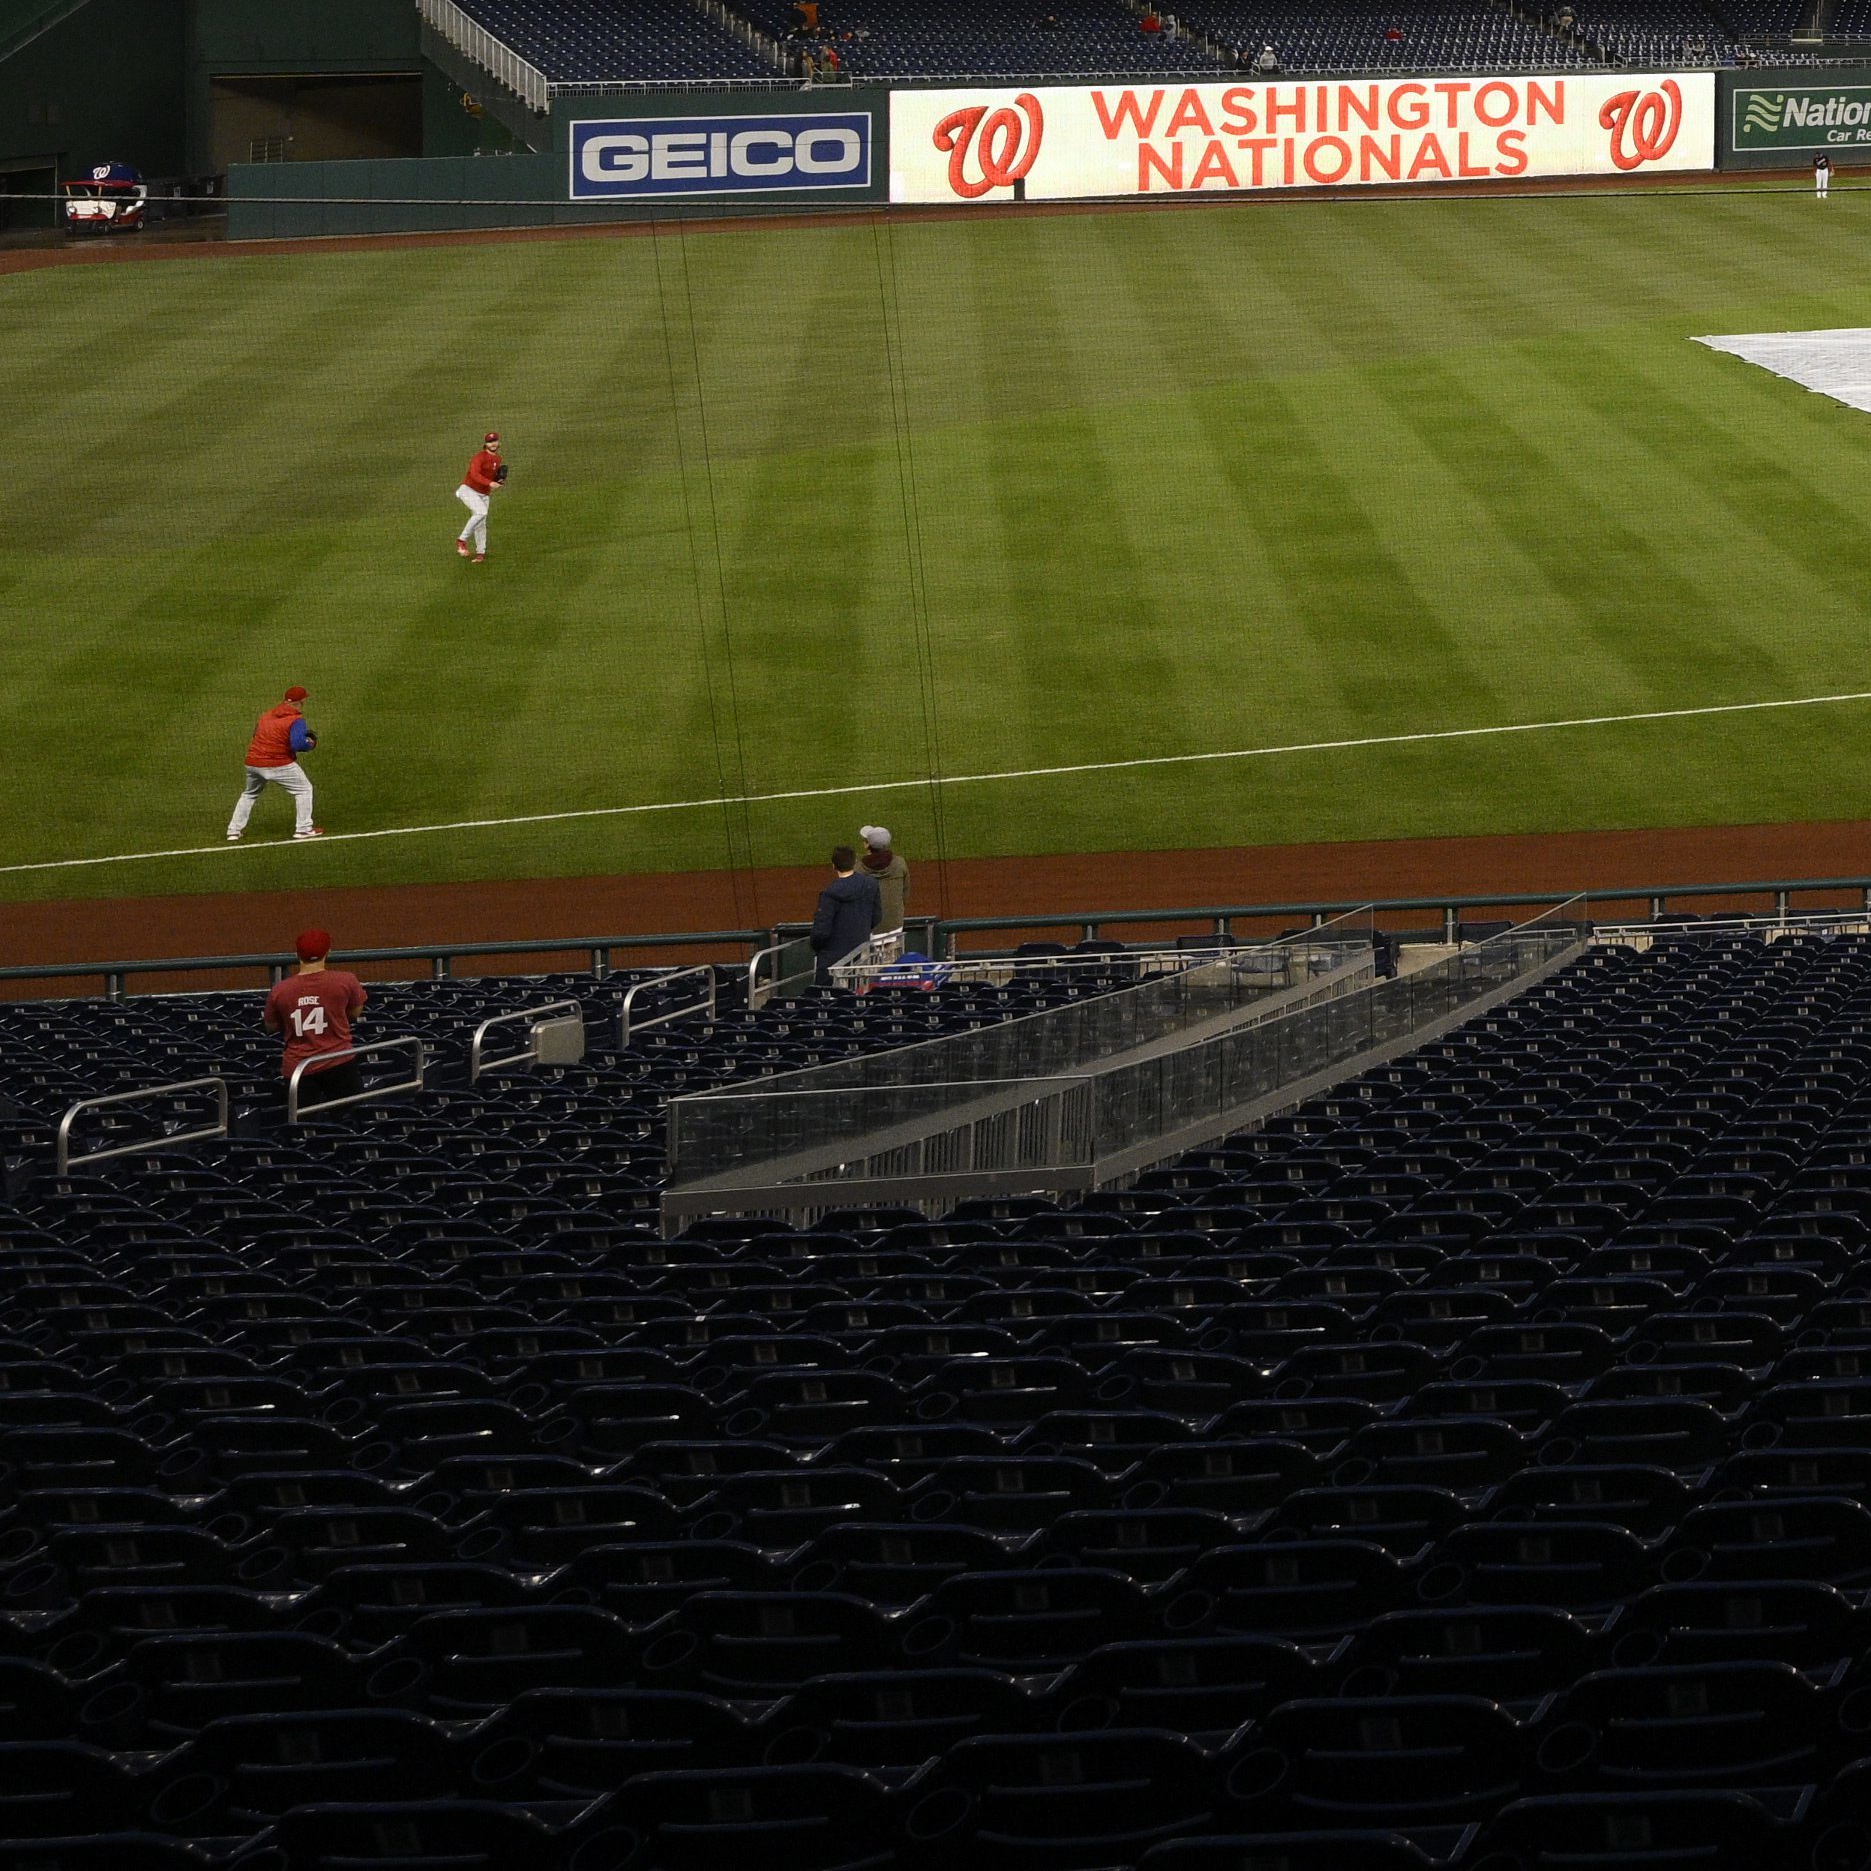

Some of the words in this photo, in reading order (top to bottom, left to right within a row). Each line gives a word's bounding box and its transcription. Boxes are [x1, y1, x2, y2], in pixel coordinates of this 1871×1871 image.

[1091, 81, 1565, 140] WASHINGTON
[581, 128, 861, 182] GEICO
[1827, 129, 1852, 143] Car
[1138, 130, 1529, 192] NATIONALS
[290, 1006, 329, 1037] 14
[297, 995, 320, 1007] ROSE
